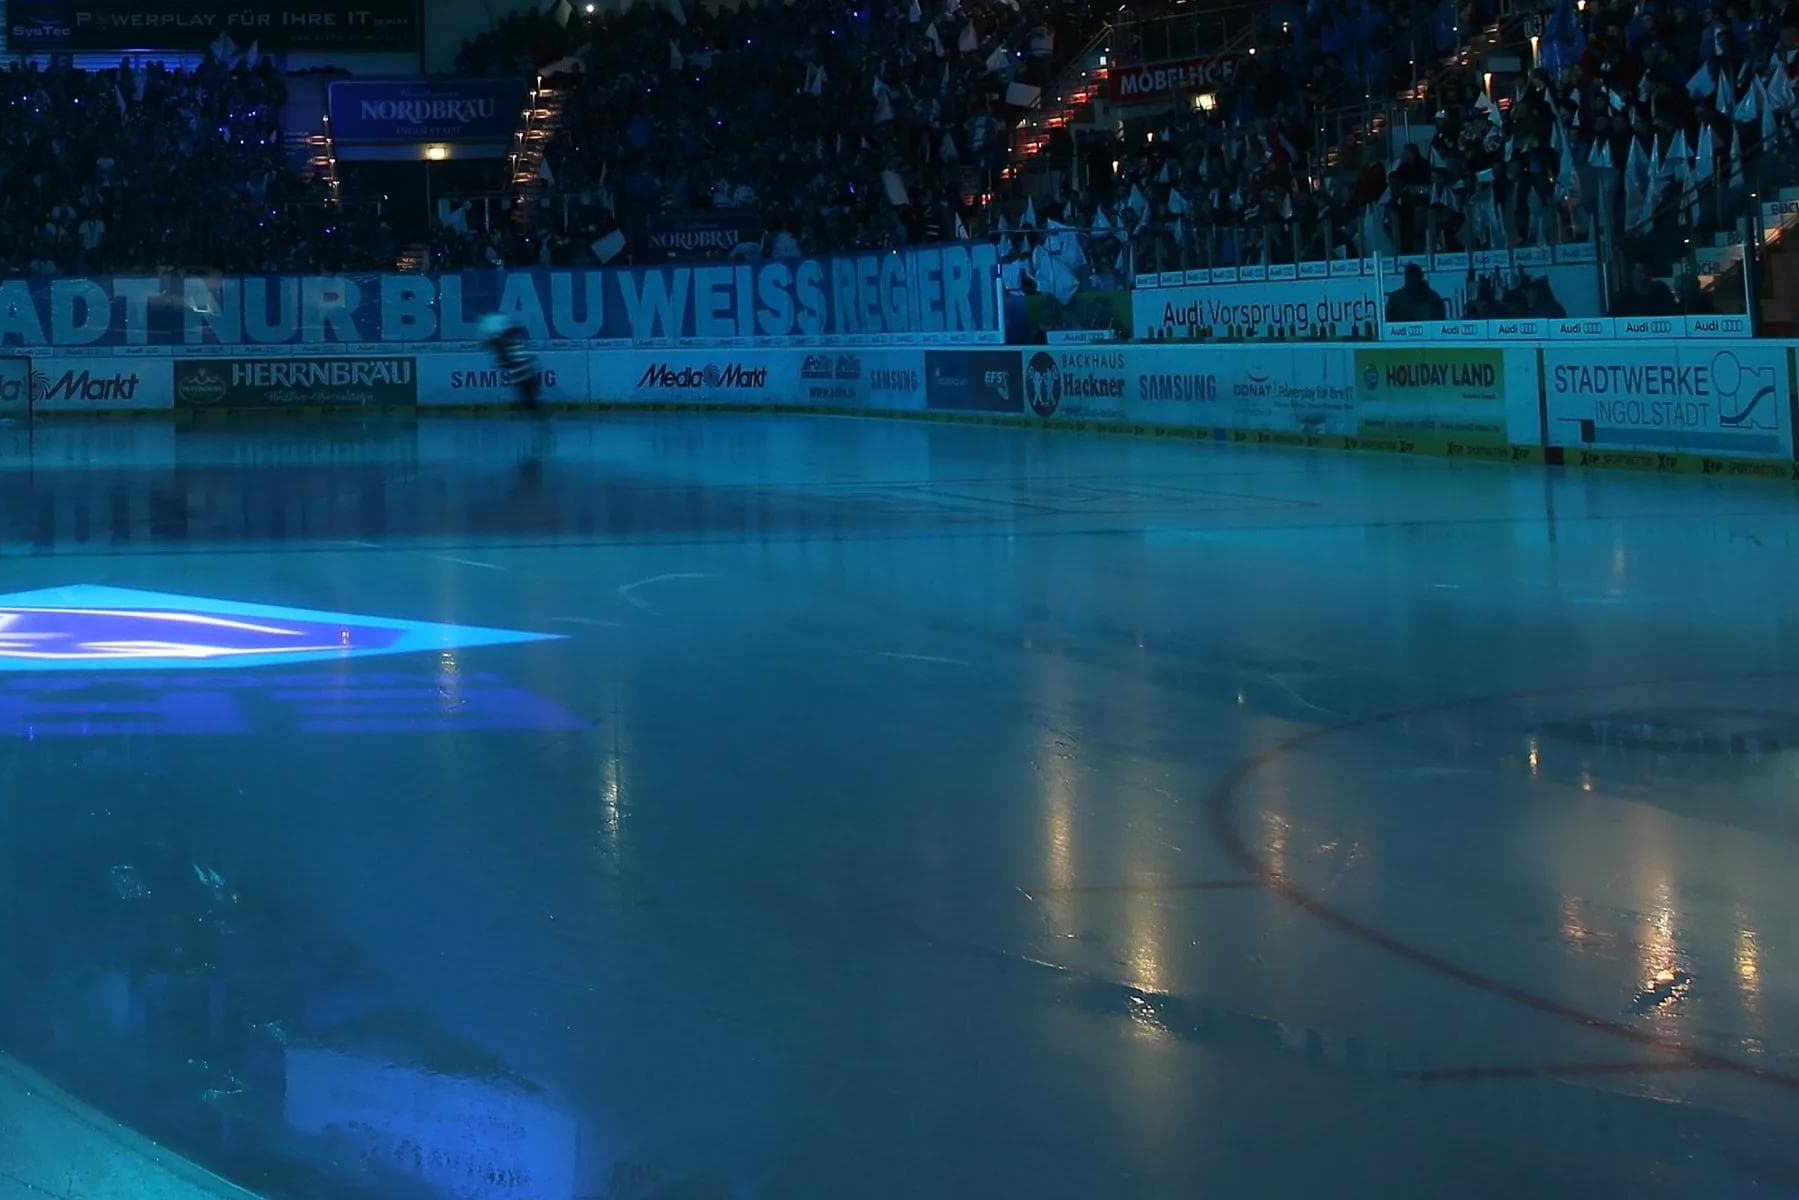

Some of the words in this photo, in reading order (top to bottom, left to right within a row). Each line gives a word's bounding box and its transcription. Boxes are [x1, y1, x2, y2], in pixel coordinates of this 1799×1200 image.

[360, 98, 496, 125] NORDBRÄU
[184, 272, 364, 345] NUR
[380, 269, 604, 342] BLAU
[618, 257, 827, 342] WEISS
[831, 241, 1000, 335] REGIERT
[1163, 300, 1204, 327] Audi
[1208, 296, 1309, 331] Vorsprung
[1317, 291, 1378, 323] durch
[1391, 326, 1407, 336] Audi
[1441, 325, 1459, 335] Audi
[1499, 324, 1518, 334] Audi
[1560, 323, 1581, 334] Audi
[1626, 322, 1649, 333] Audi
[1694, 320, 1718, 332] Audi
[1062, 352, 1125, 368] BACKHAUS
[42, 369, 139, 402] Markt
[231, 358, 412, 388] HERRNBRÄU
[637, 362, 704, 390] Media
[716, 362, 768, 389] Markt
[870, 368, 918, 392] SAMSUNG
[1386, 363, 1448, 387] HOLIDAY
[1452, 363, 1495, 387] LAND
[1554, 364, 1710, 396] STADTWERKE
[1062, 374, 1126, 399] Hackner
[1138, 374, 1216, 402] SAMSUNG
[1595, 400, 1710, 427] INGOLSTADT
